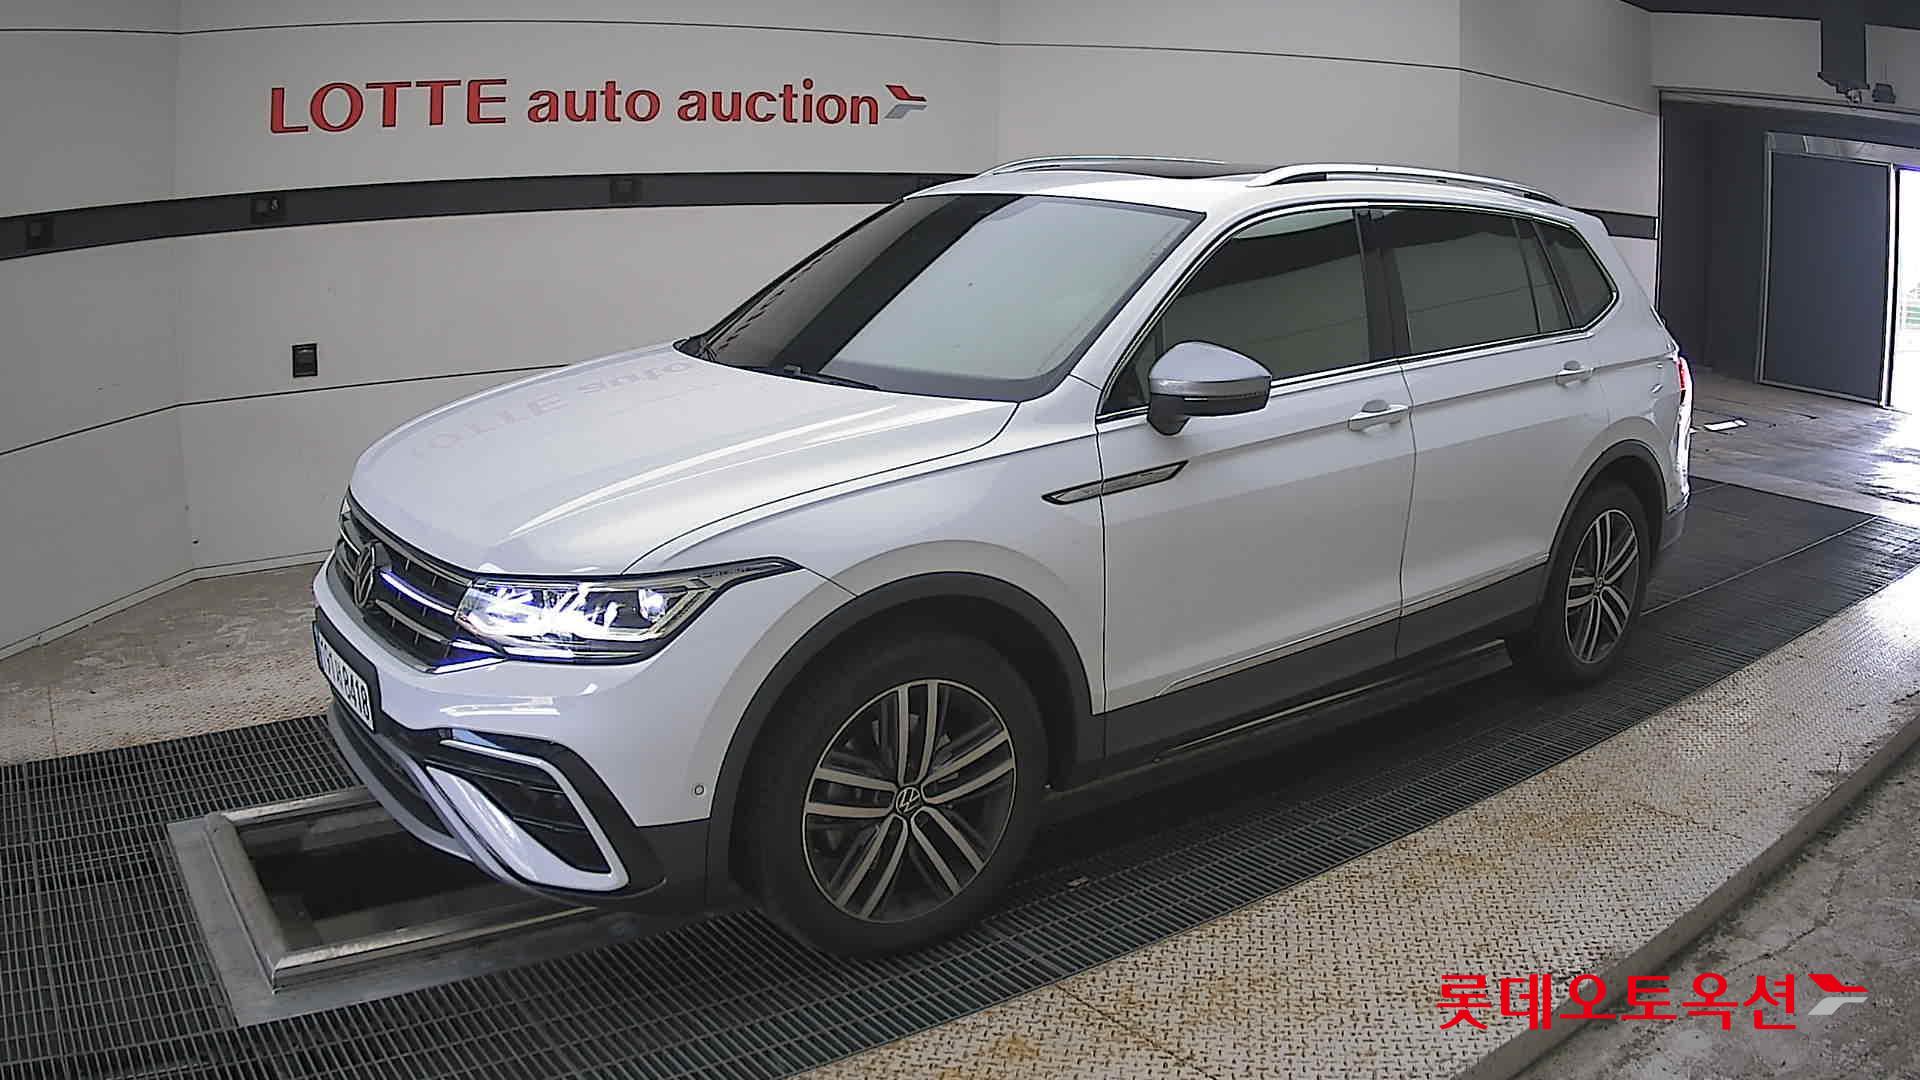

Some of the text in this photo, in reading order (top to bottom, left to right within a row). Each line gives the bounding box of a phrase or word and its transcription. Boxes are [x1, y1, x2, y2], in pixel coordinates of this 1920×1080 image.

[270, 78, 879, 133] LOTTE auto auction
